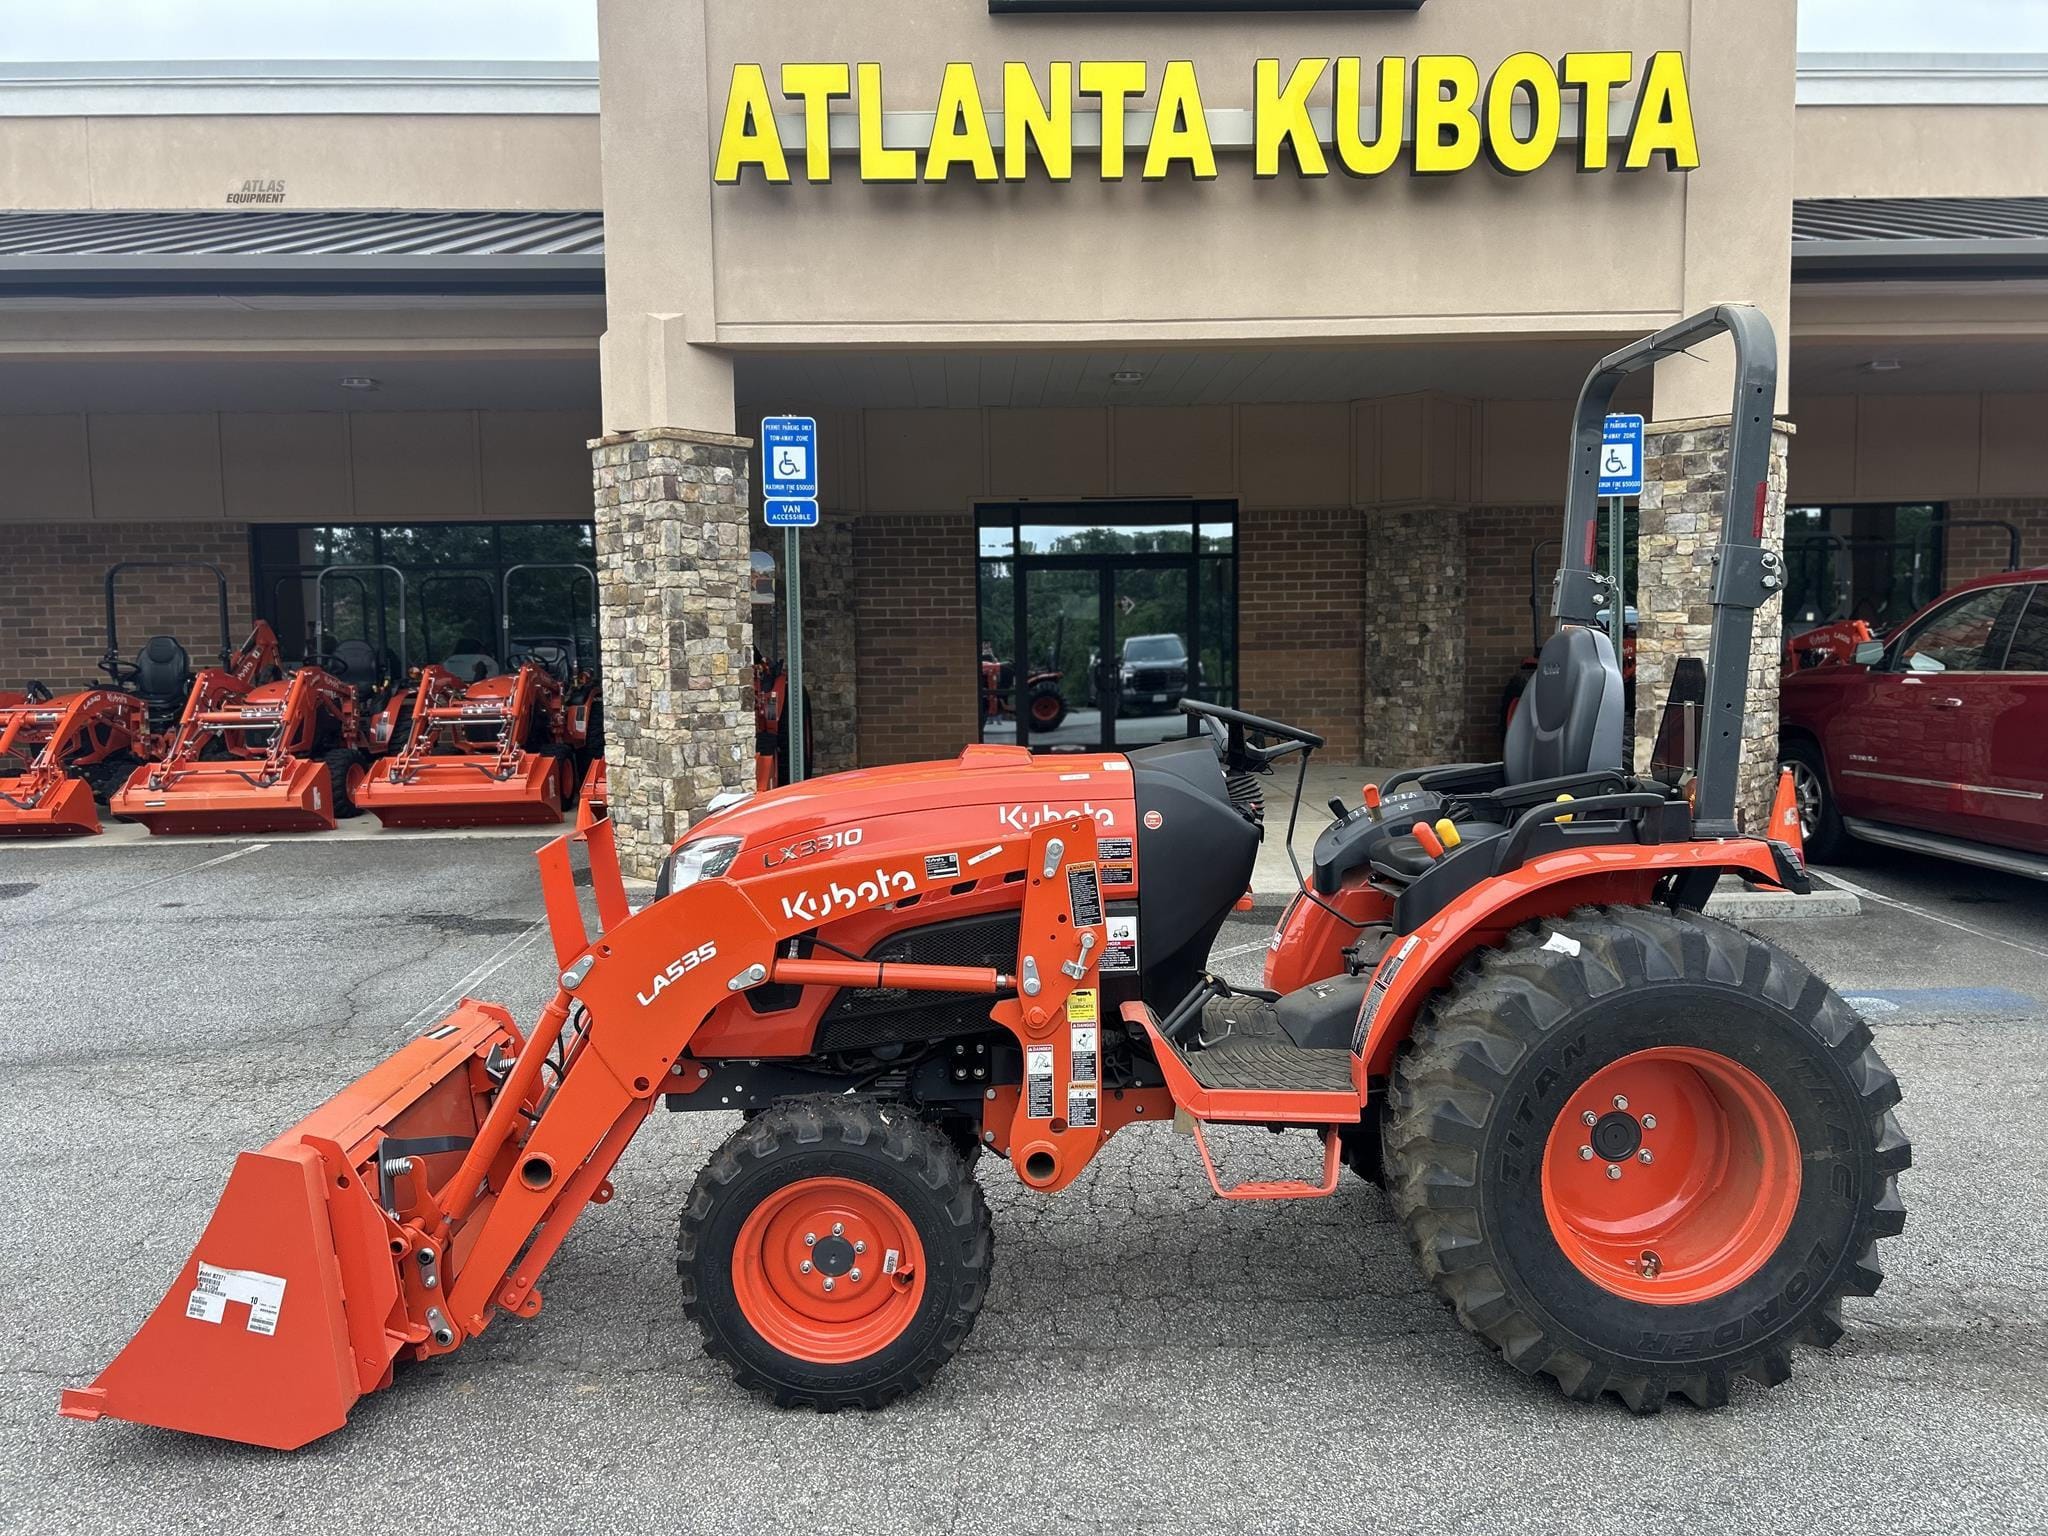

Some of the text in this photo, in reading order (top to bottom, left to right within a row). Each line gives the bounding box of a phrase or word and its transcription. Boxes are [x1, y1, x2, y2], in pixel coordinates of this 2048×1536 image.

[714, 51, 1701, 185] ATLANTA KUBOTA
[226, 192, 286, 204] EQUIPMENT
[242, 179, 286, 194] ATLAS
[782, 504, 801, 513] VAN
[999, 802, 1115, 830] Kubota
[763, 828, 864, 868] LX3310
[781, 868, 916, 921] Kubota
[636, 940, 718, 1007] LA535
[1500, 1033, 1587, 1186] TITAN
[1636, 1237, 1833, 1357] LOADER
